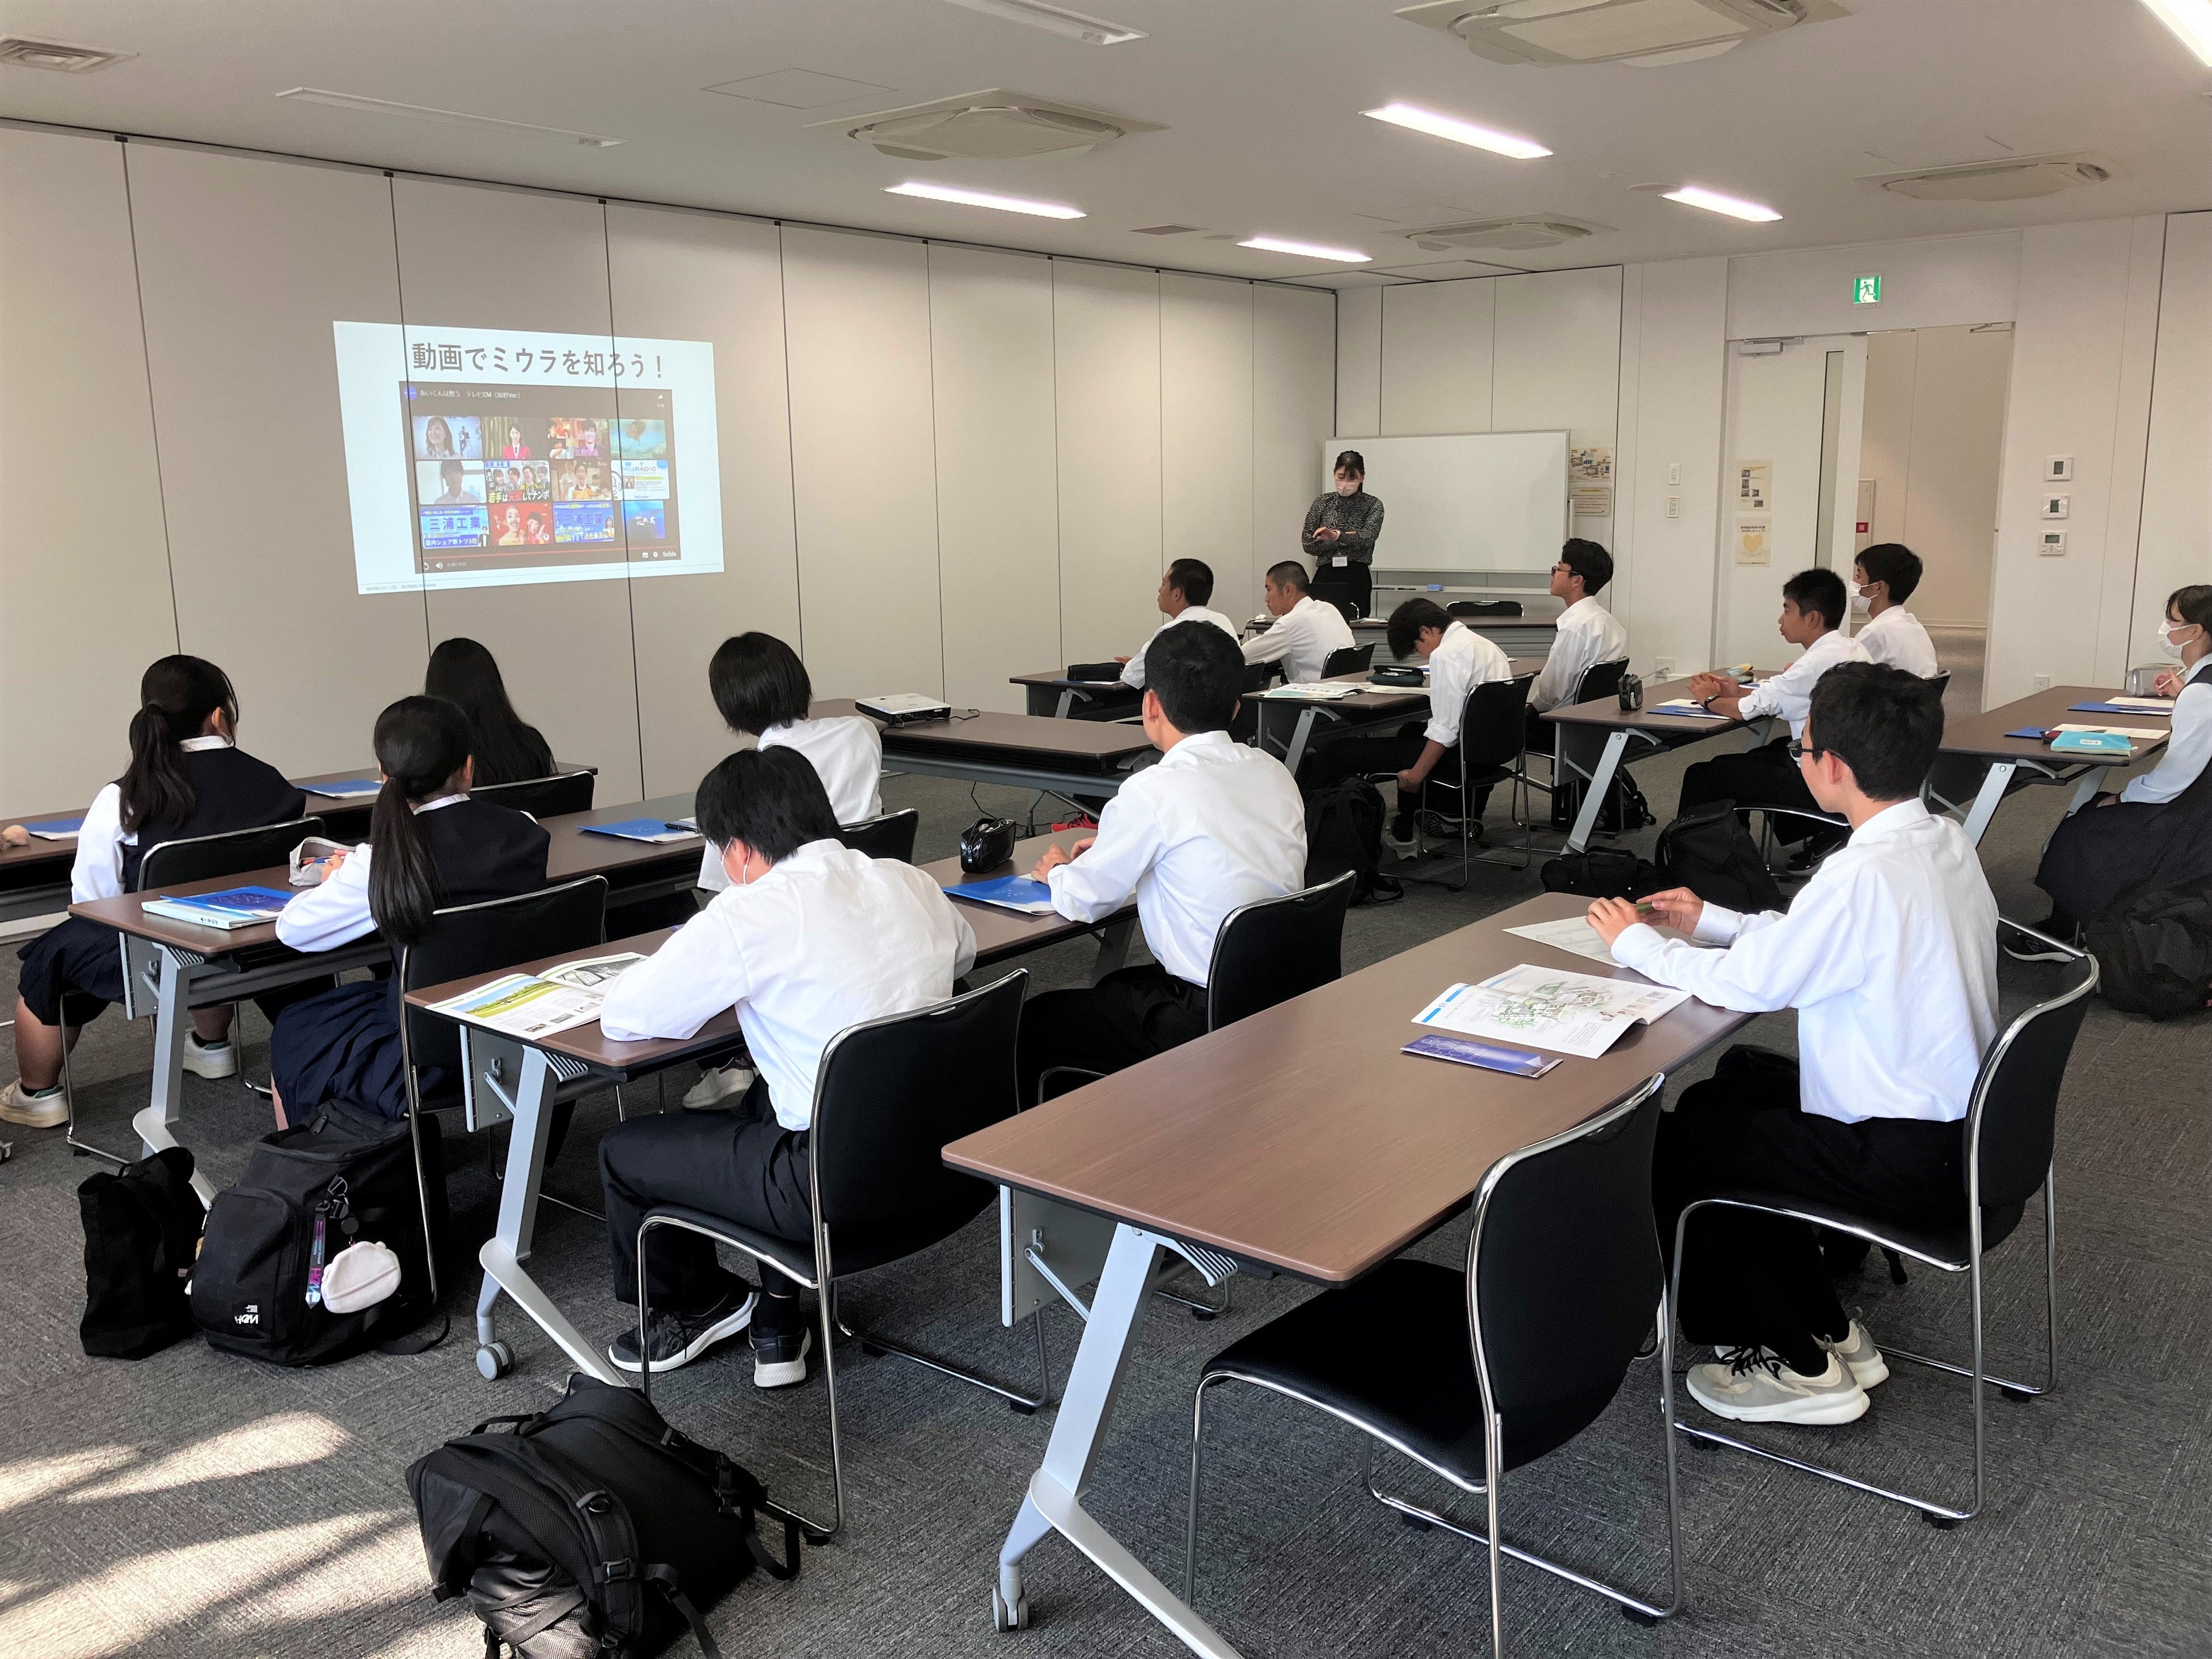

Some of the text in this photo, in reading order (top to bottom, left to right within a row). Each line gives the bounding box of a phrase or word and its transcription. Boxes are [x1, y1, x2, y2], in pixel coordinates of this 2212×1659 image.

[429, 516, 481, 530] 三浦工業
[563, 512, 604, 526] 三浦工業
